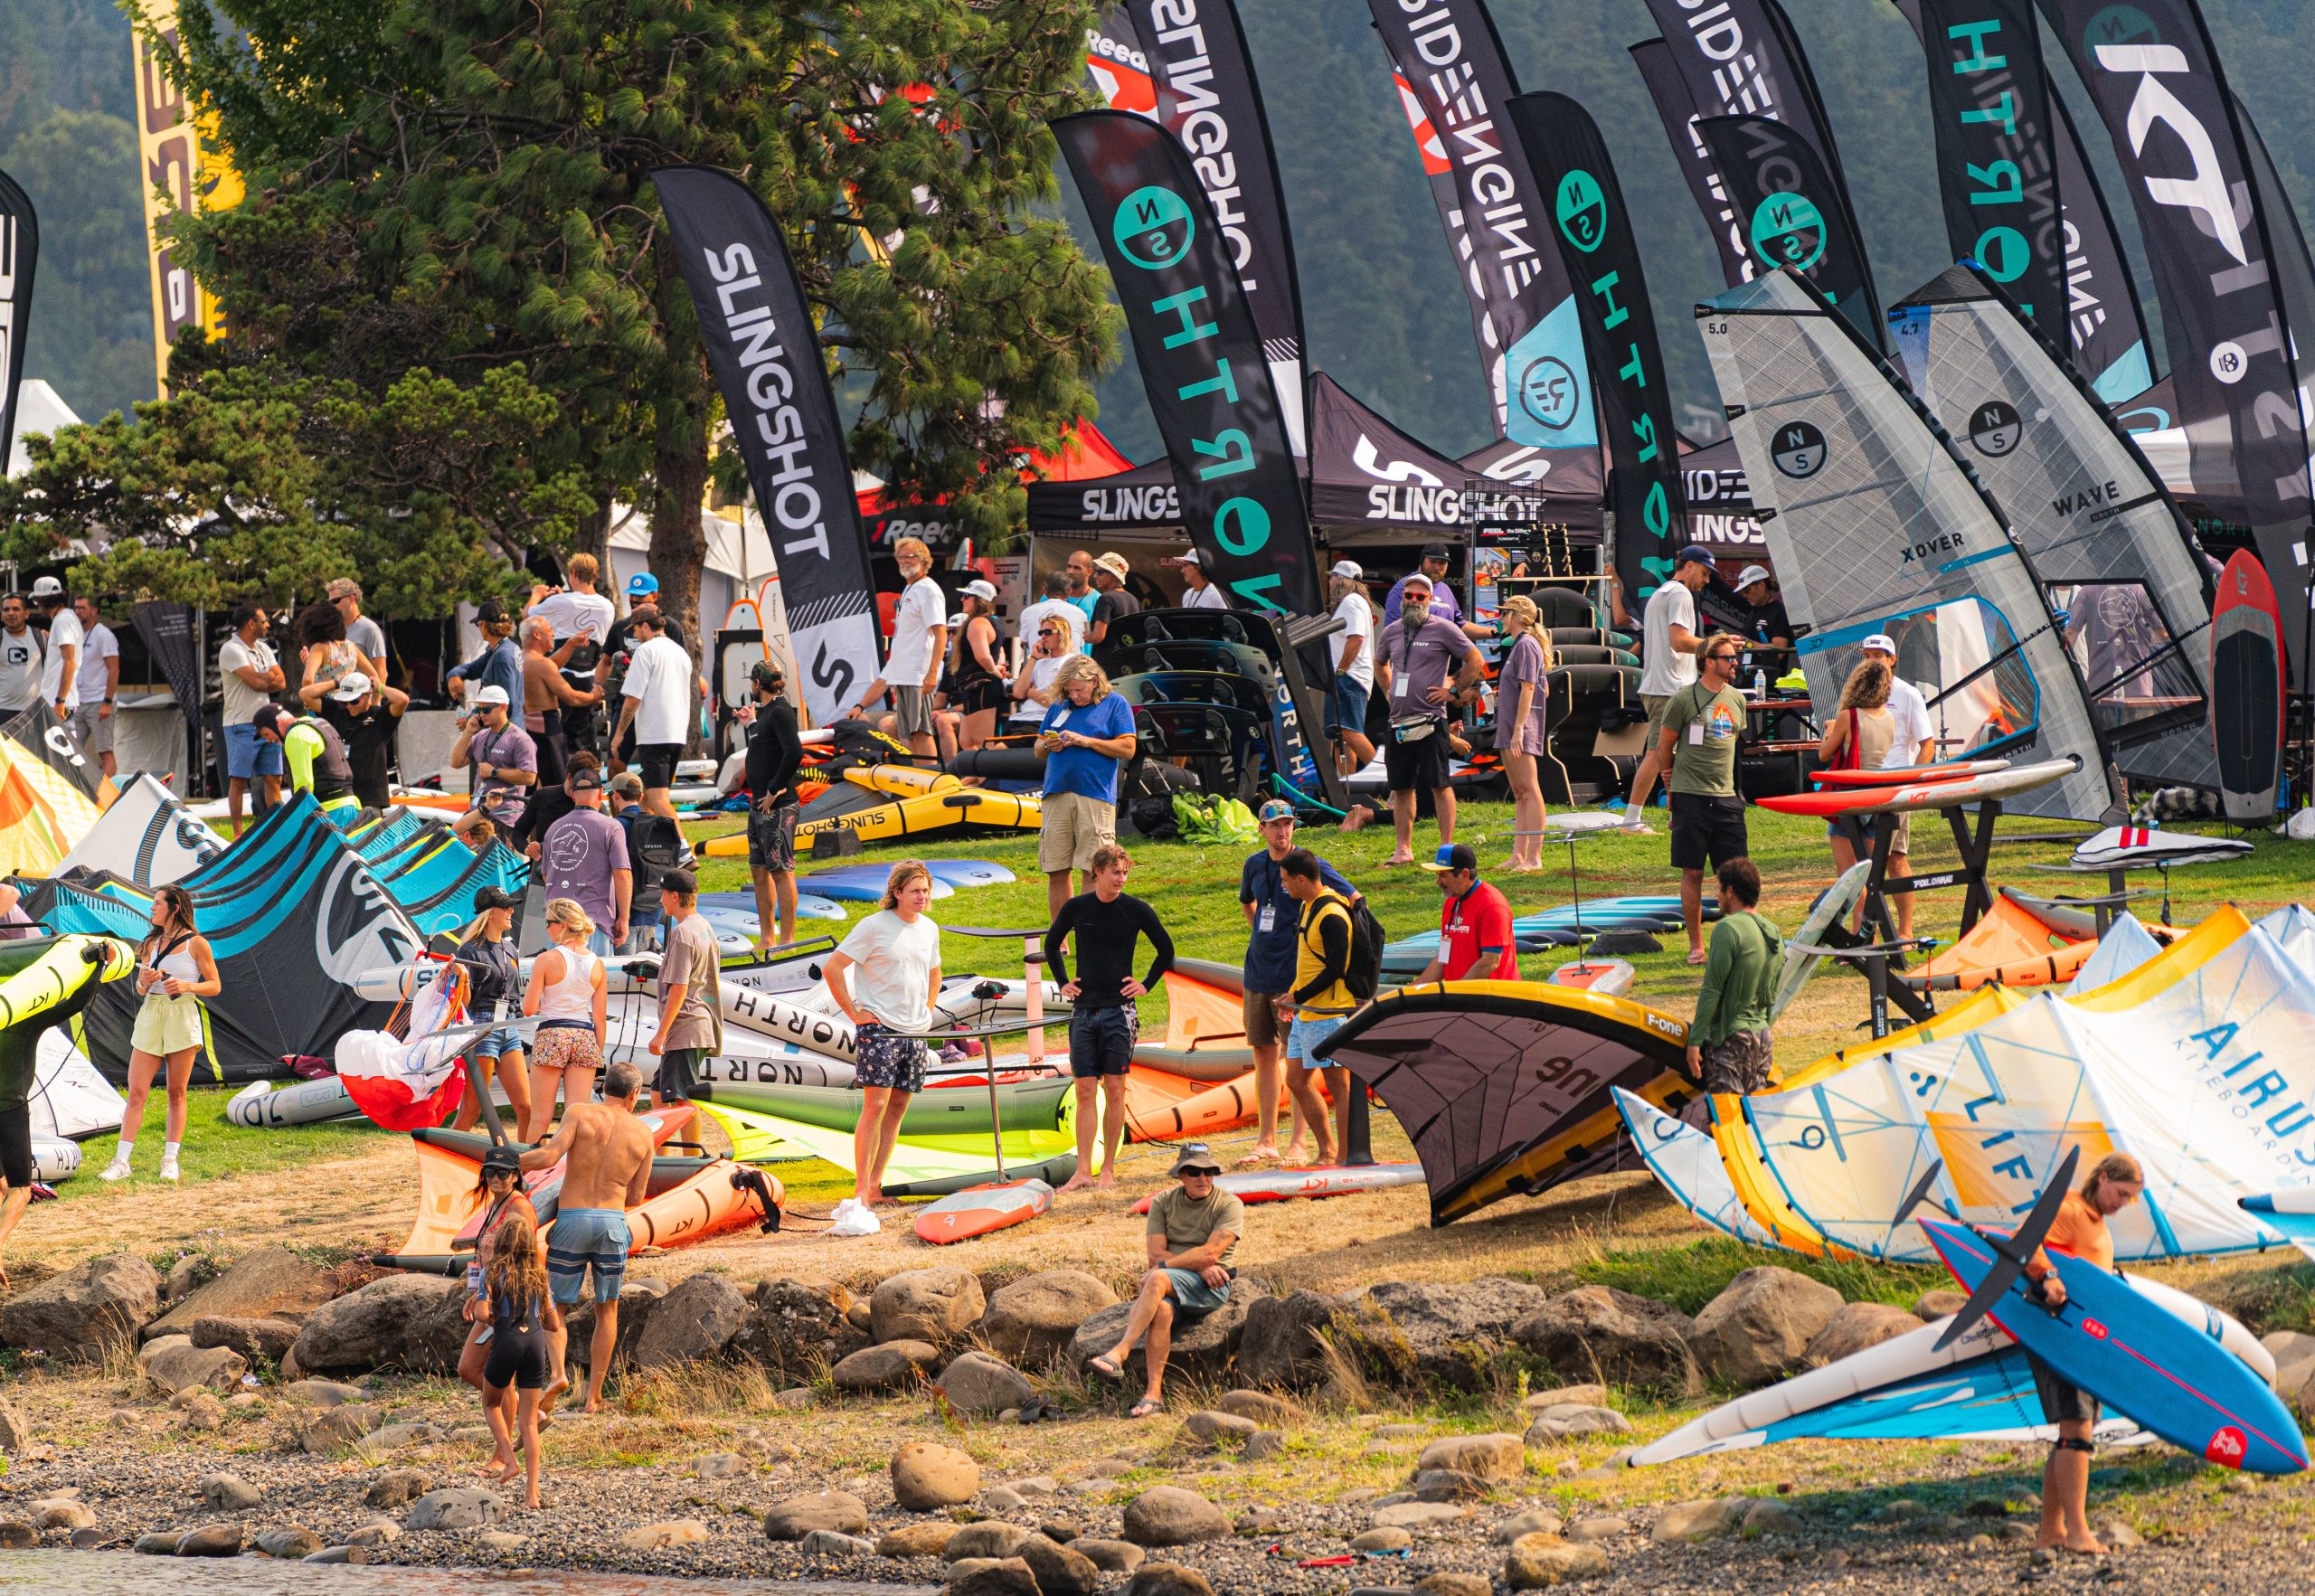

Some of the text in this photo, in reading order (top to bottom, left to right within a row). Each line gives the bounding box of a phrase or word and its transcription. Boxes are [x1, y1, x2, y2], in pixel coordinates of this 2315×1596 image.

[1708, 323, 1728, 335] 5.0
[1901, 323, 1920, 335] 4.7
[704, 242, 830, 561] SLINGSHOT
[1082, 488, 1181, 522] SLINGS
[1366, 485, 1547, 524] SLINGSHOT
[2053, 480, 2120, 516] WAVE
[2197, 517, 2251, 536] NORT
[1901, 532, 1965, 564] XOVER
[733, 991, 858, 1055] NORTH
[699, 1057, 803, 1086] NORT
[1964, 1091, 2043, 1216] LIFT
